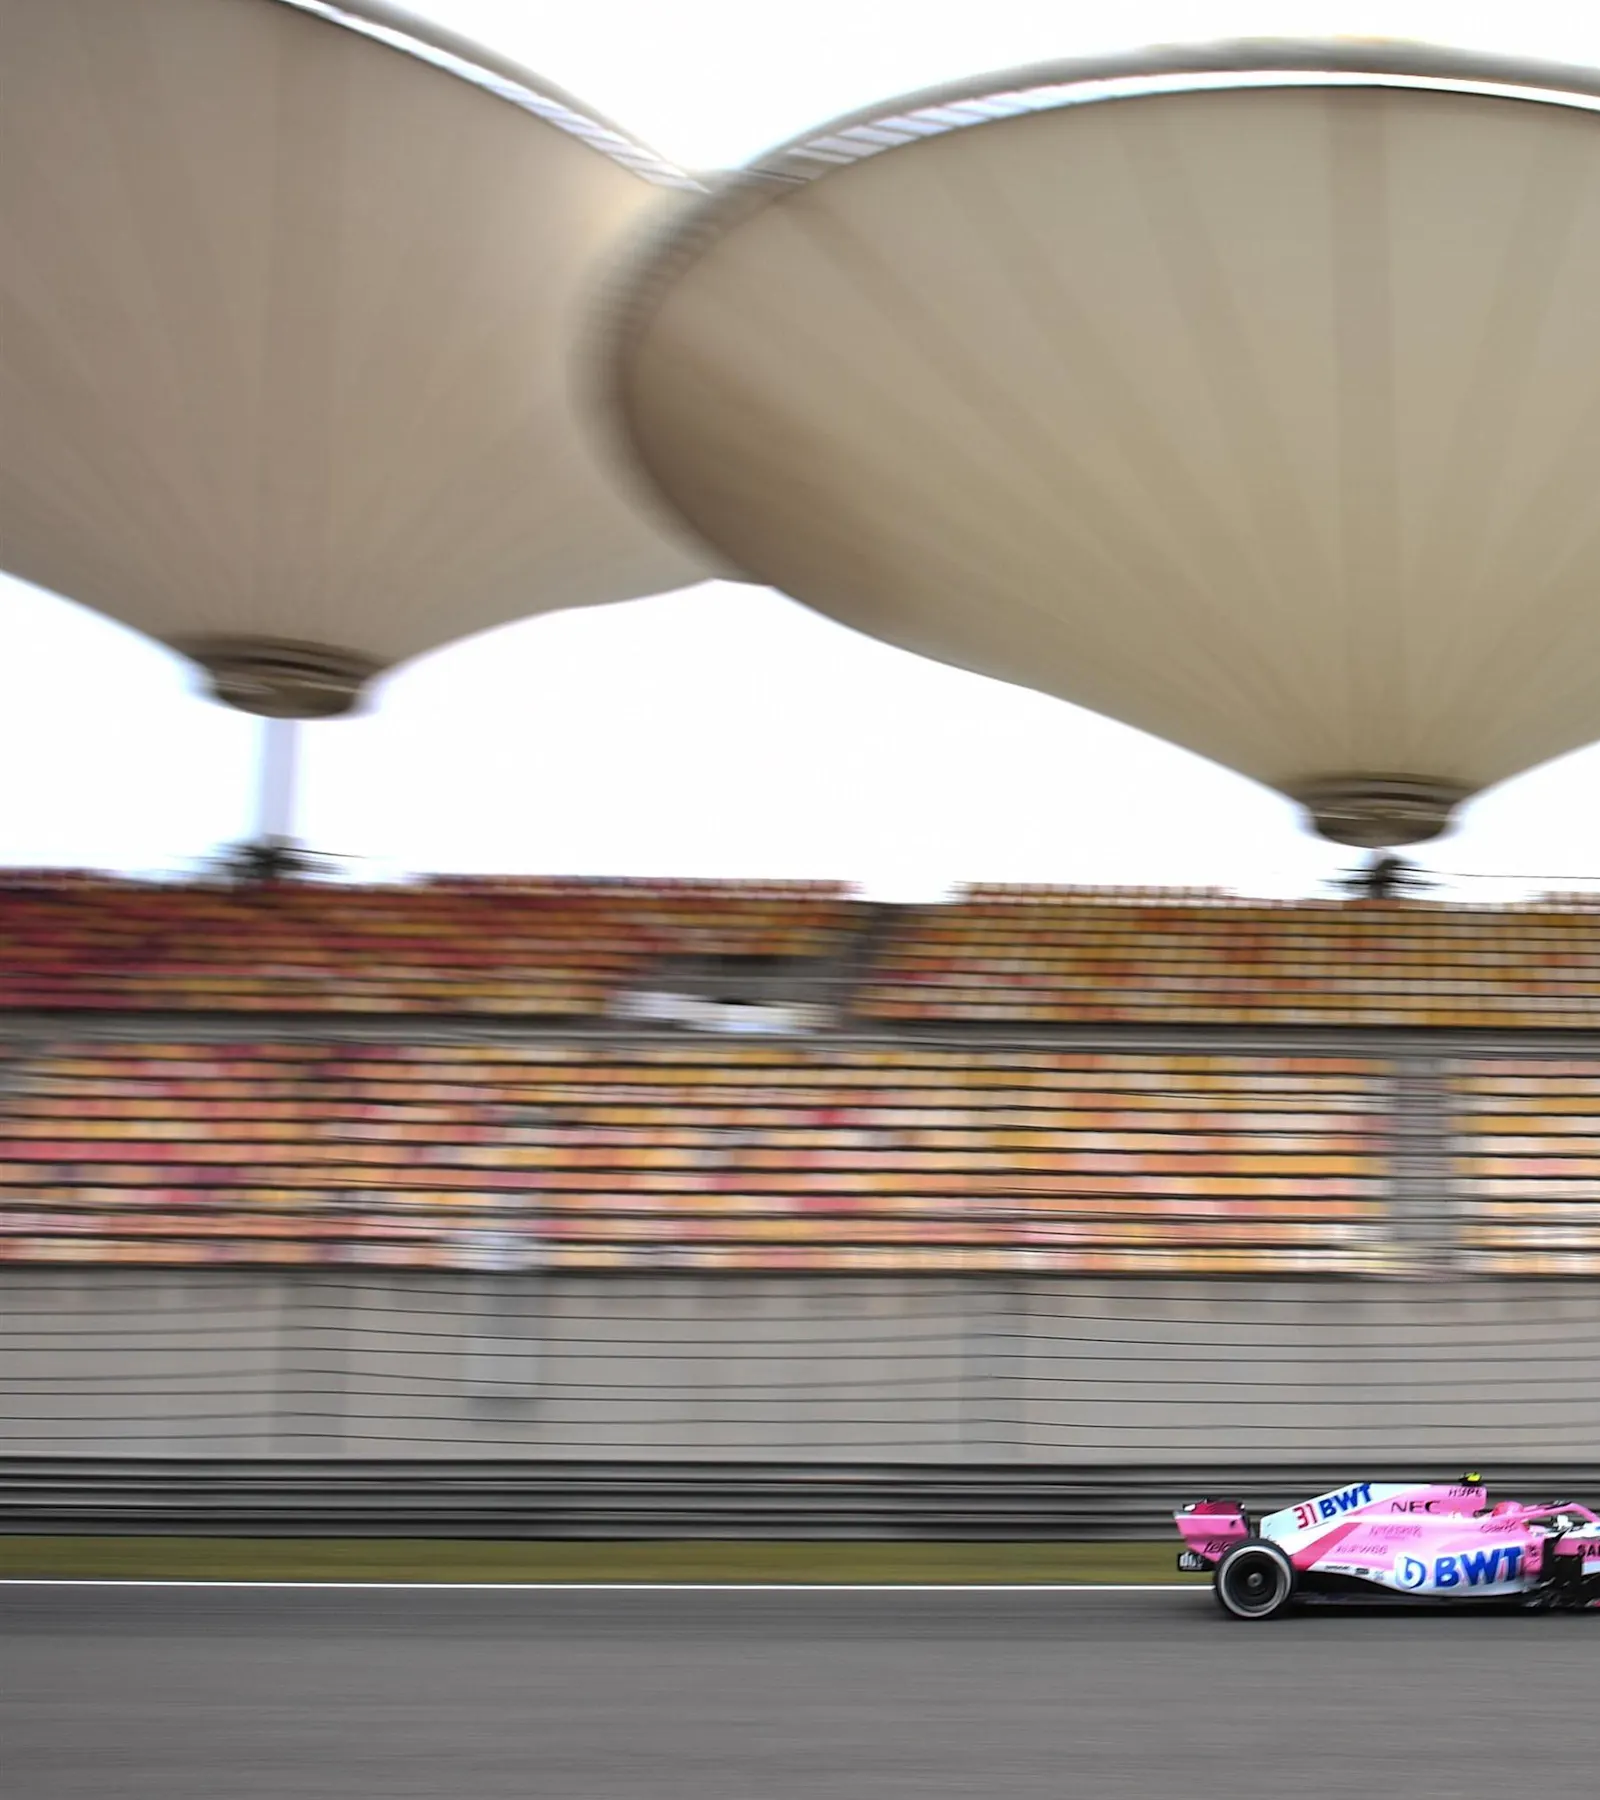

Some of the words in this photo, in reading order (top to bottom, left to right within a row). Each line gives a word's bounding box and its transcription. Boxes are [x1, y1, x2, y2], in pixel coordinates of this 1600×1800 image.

[1293, 1503, 1318, 1530] 31
[1318, 1482, 1372, 1519] BWT
[1391, 1501, 1441, 1514] NEC
[1435, 1545, 1522, 1588] BWT
